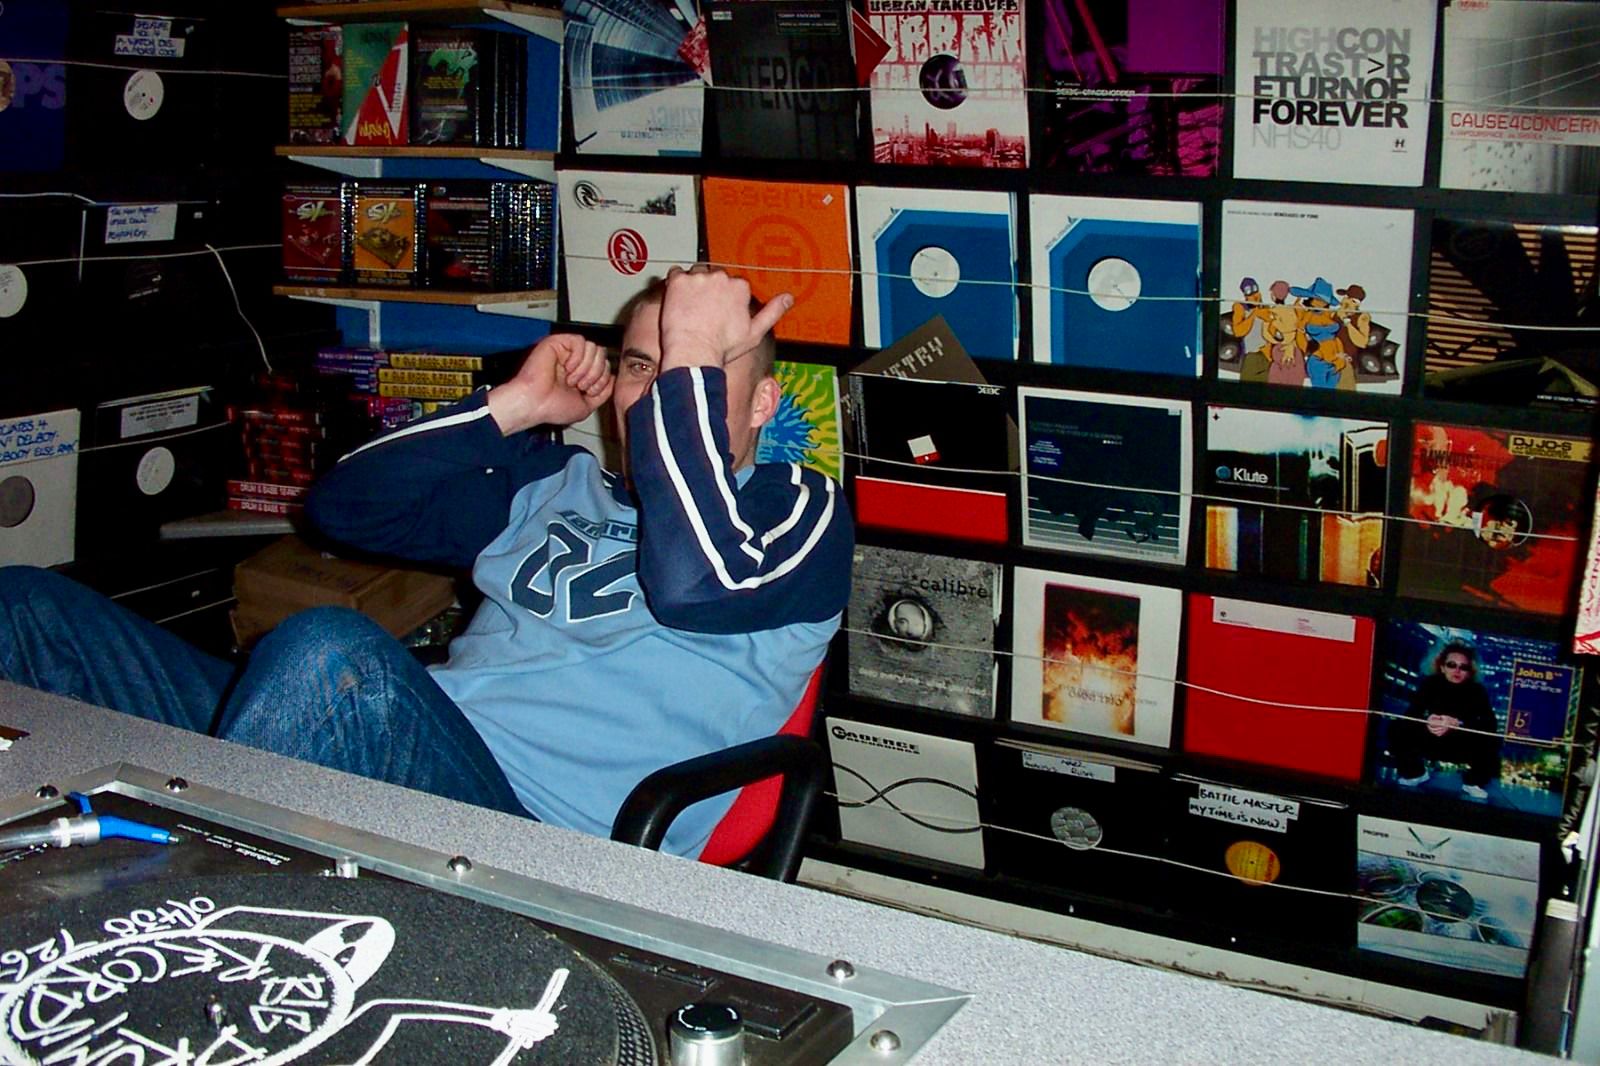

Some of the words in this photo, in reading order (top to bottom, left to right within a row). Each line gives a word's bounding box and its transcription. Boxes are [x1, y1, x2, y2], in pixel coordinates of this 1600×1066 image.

[1252, 100, 1409, 129] FOREVER
[1450, 112, 1600, 134] CAUSE4CONCERN
[1513, 437, 1534, 447] DJ
[1233, 467, 1269, 484] Klute
[920, 578, 988, 598] calibre
[1516, 667, 1544, 679] John
[1545, 671, 1553, 681] B
[1406, 850, 1436, 861] TALENT
